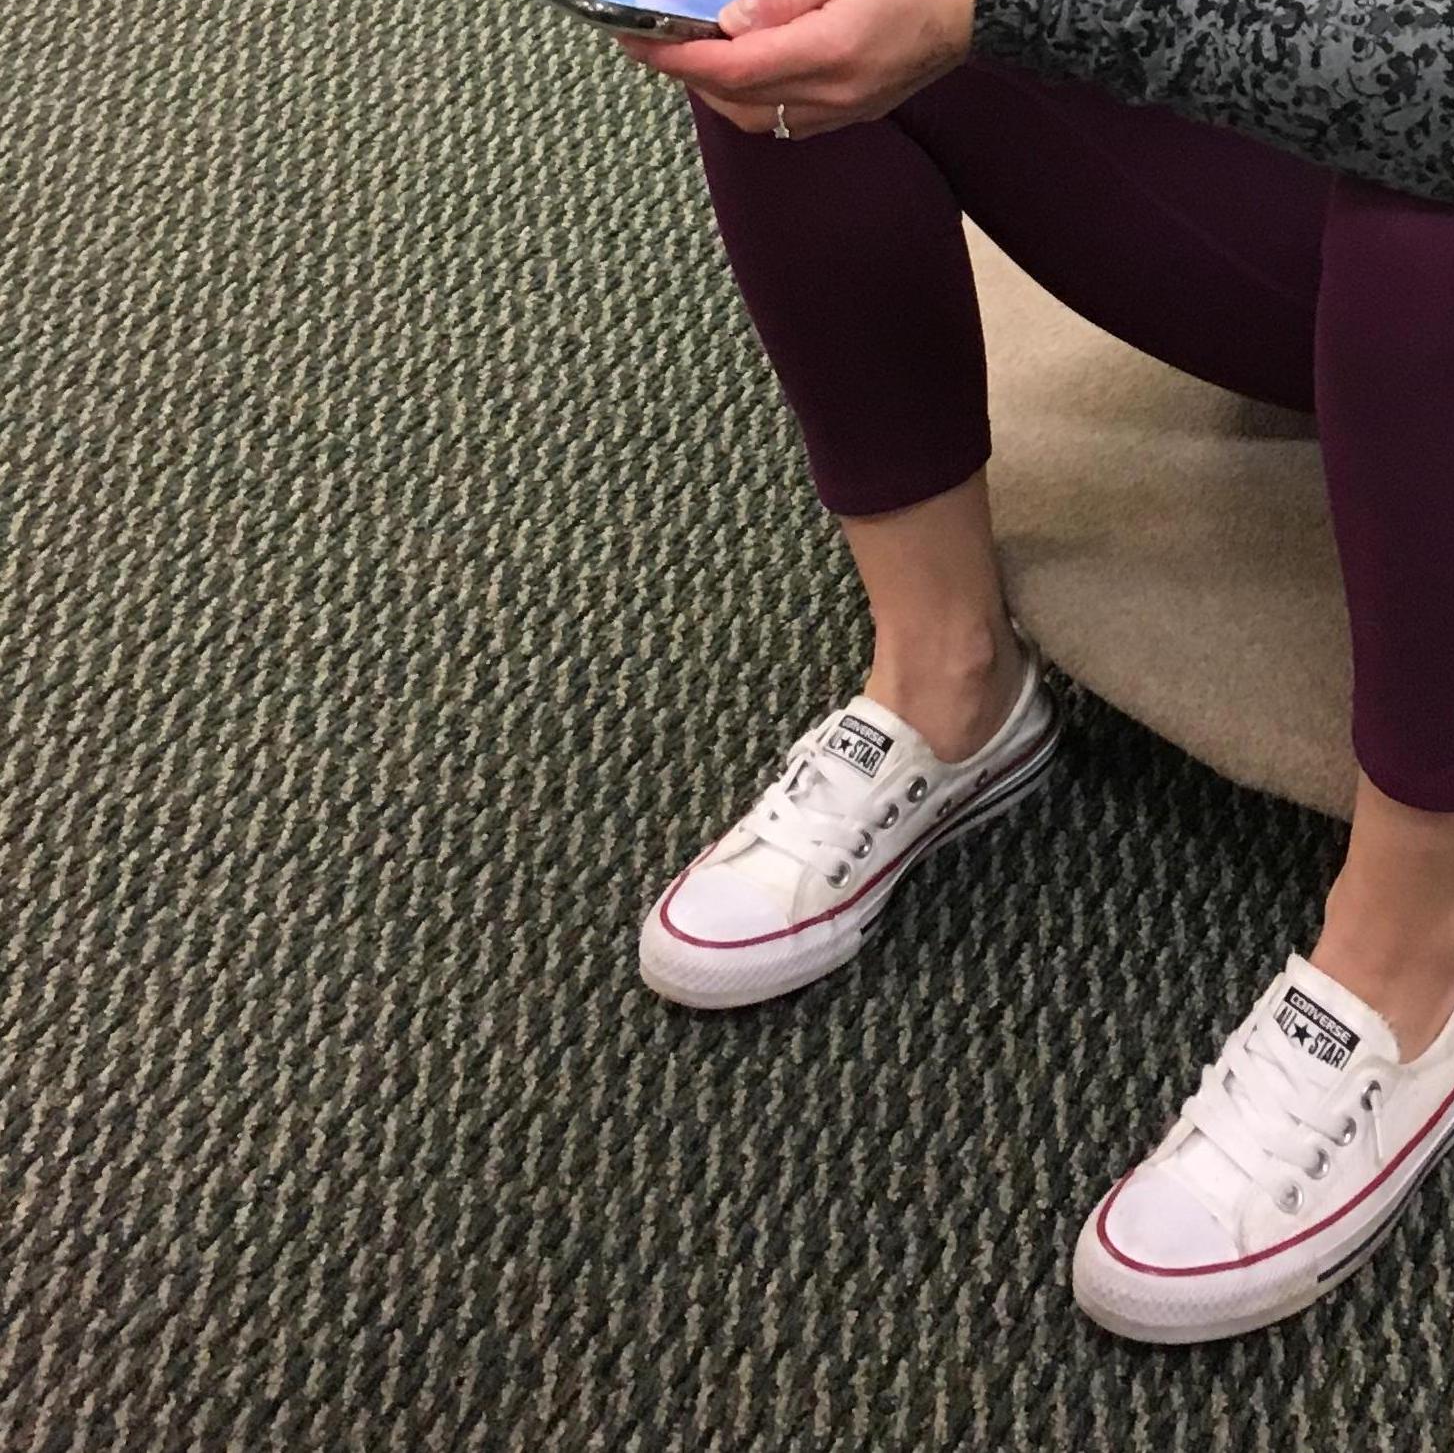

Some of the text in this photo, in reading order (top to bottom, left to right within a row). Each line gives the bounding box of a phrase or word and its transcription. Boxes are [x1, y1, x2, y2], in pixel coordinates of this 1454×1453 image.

[849, 740, 880, 771] STAR
[1276, 1006, 1345, 1068] ALL STAR
[1290, 993, 1351, 1044] CONVERSE
